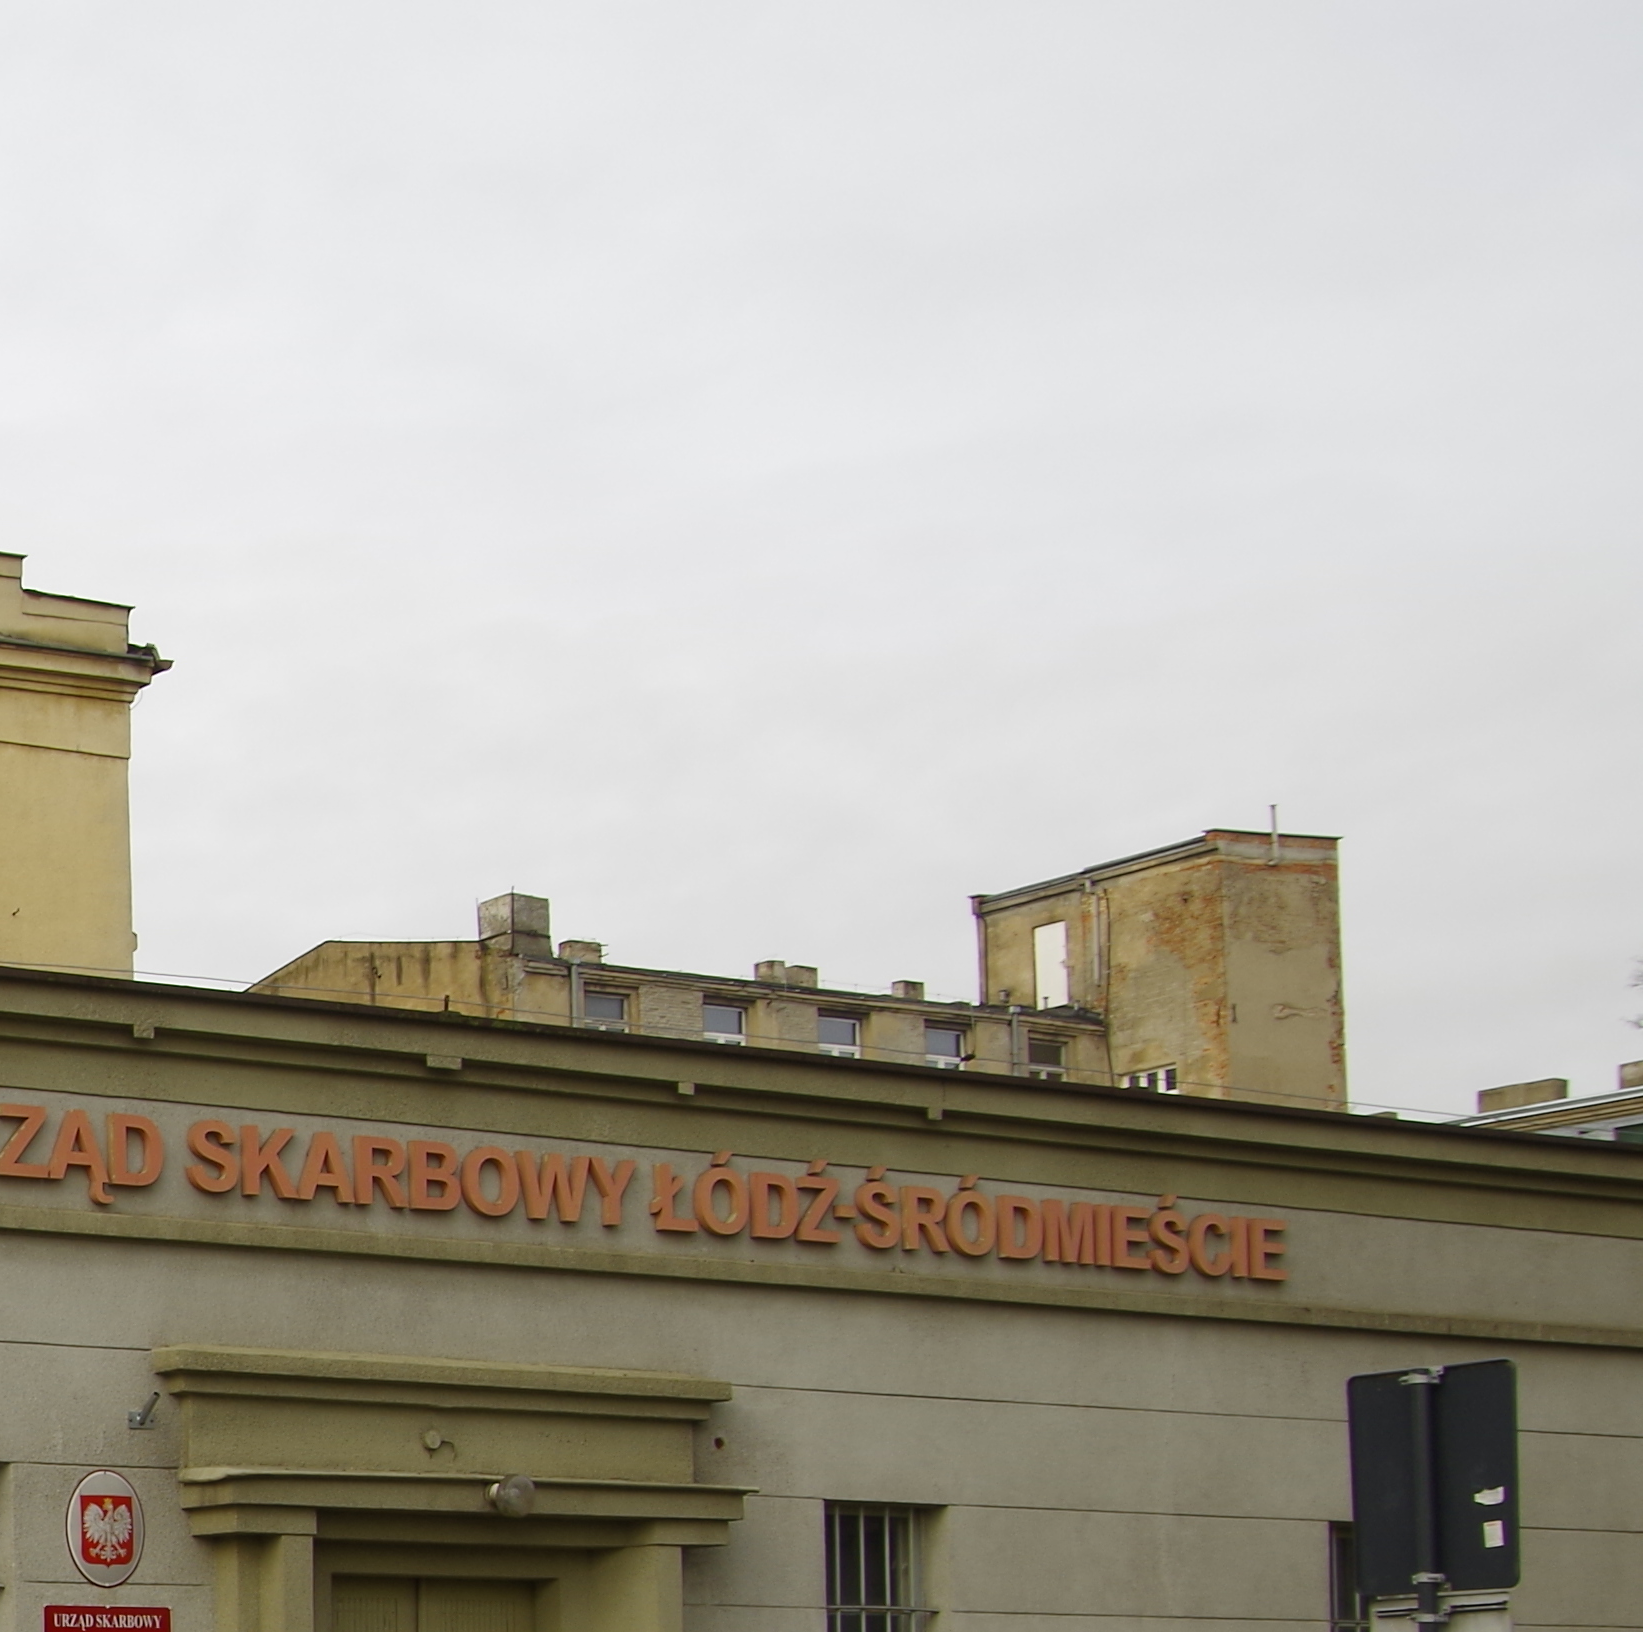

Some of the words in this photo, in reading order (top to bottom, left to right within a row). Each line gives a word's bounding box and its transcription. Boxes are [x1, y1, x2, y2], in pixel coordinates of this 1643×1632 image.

[186, 1119, 636, 1227] SKARBOWY
[648, 1152, 1288, 1281] ŁÓDŹ-ŚRÓDMIEŚCIE
[53, 1613, 95, 1632] URZĄD
[95, 1614, 162, 1629] SKARBOWY
